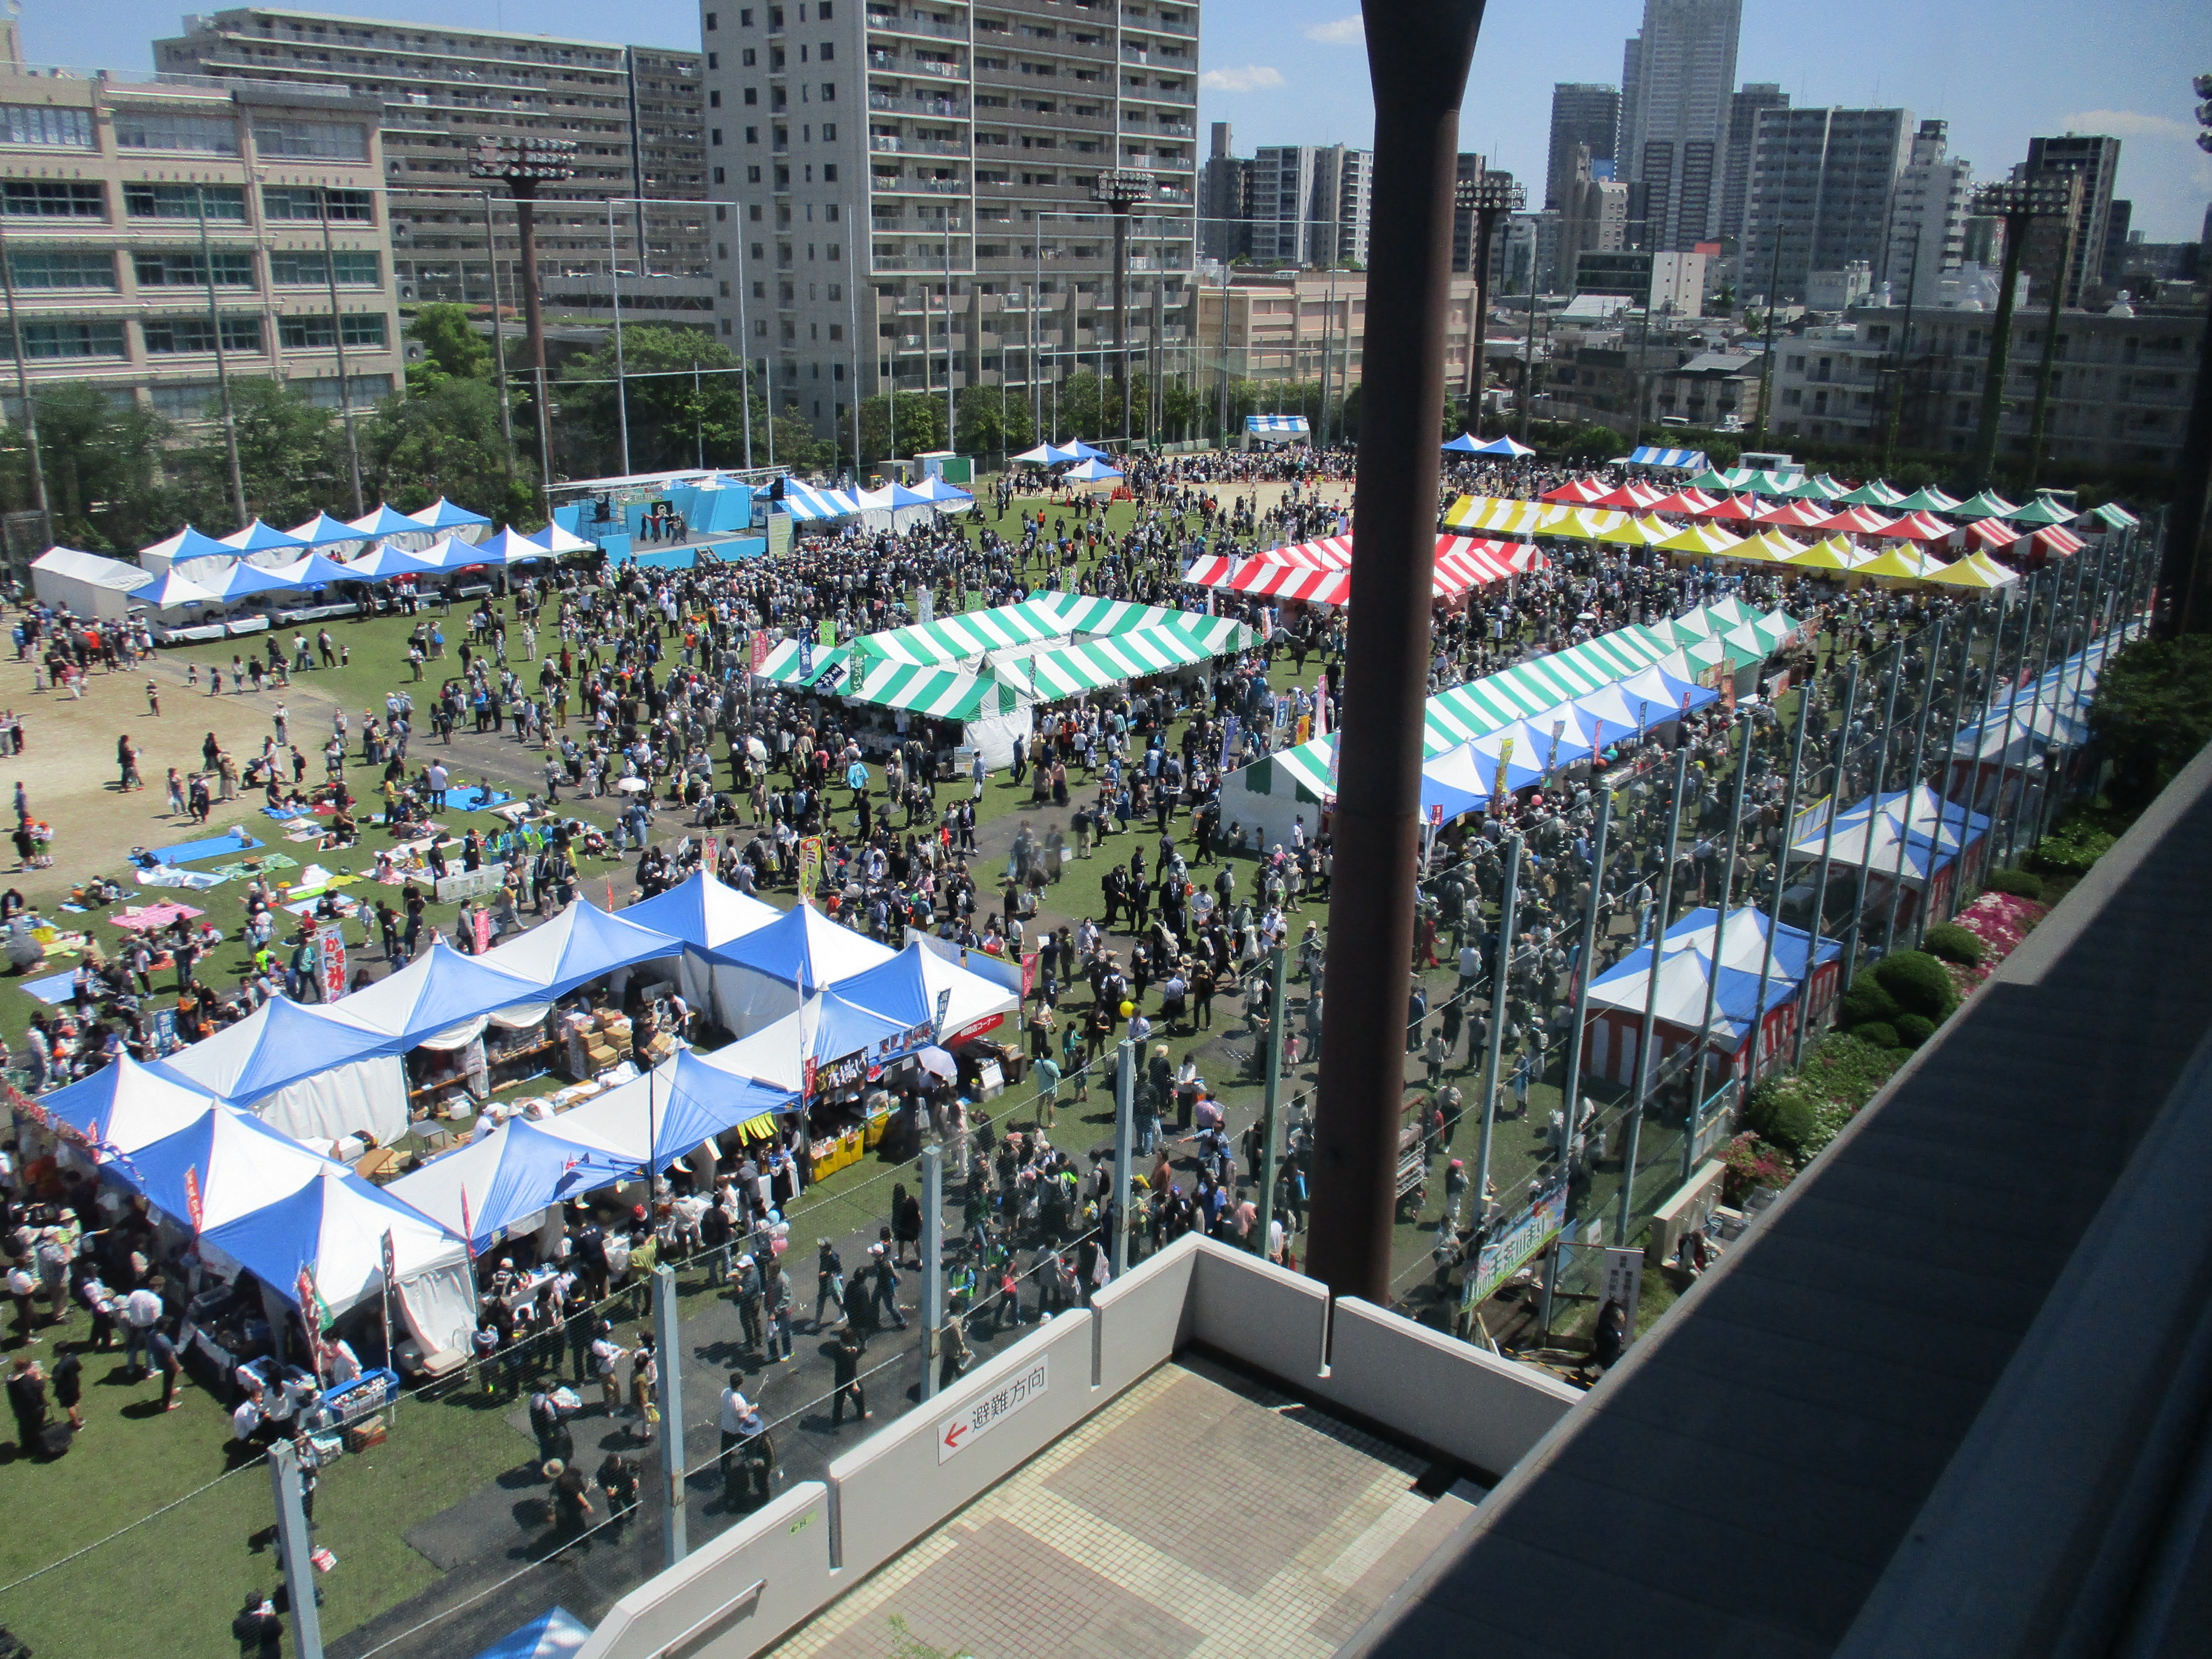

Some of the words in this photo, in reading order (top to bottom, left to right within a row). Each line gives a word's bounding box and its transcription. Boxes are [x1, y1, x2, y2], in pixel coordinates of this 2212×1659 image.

[324, 937, 345, 991] かき氷
[960, 1017, 996, 1037] 模擬店コーナー
[827, 1051, 867, 1090] 唐揚げ
[972, 1366, 1044, 1432] 避難方向
